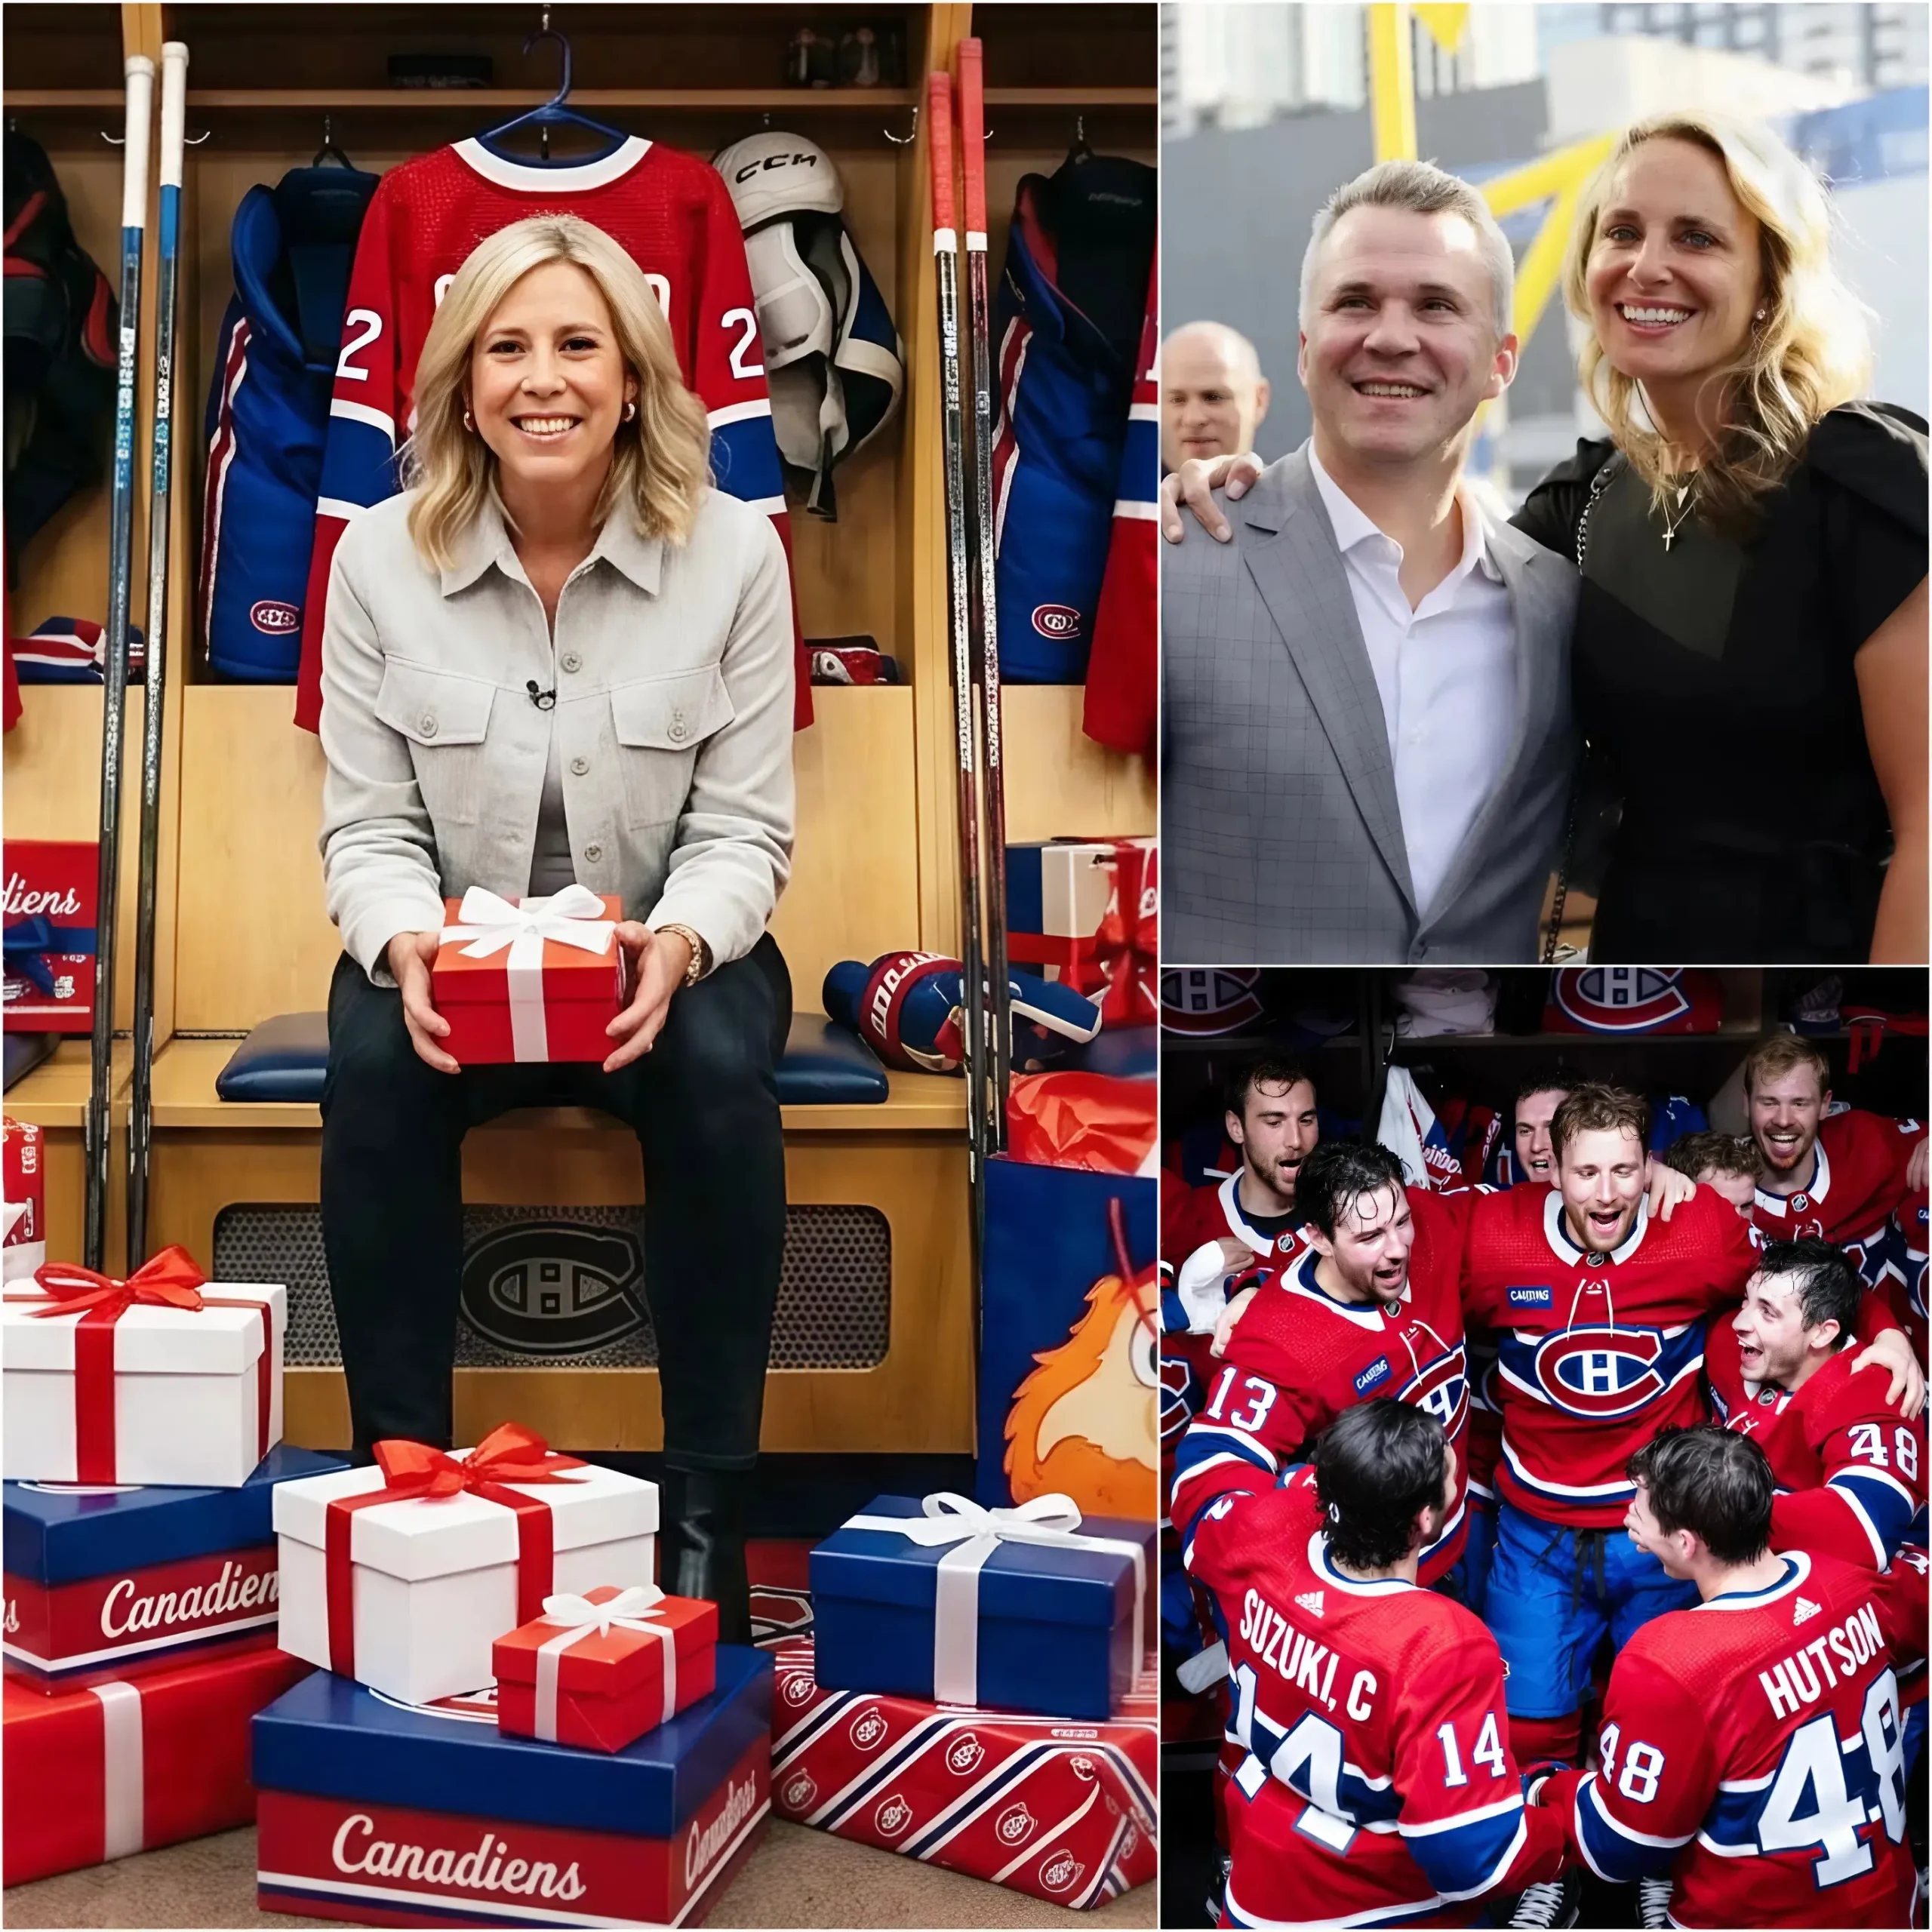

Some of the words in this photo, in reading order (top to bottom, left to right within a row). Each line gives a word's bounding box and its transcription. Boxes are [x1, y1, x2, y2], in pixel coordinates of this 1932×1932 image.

[335, 309, 383, 381] 2
[721, 308, 764, 379] 2
[1208, 1367, 1277, 1432] 13
[1847, 1423, 1918, 1481] 48
[1240, 1588, 1340, 1712] SUZUKI,
[1346, 1669, 1377, 1721] C
[1758, 1602, 1885, 1721] HUTSON
[1232, 1662, 1358, 1854] 14
[1437, 1712, 1506, 1788] 14
[1600, 1723, 1665, 1804] 48
[1757, 1666, 1907, 1887] 48
[332, 1814, 587, 1900] Canadiens
